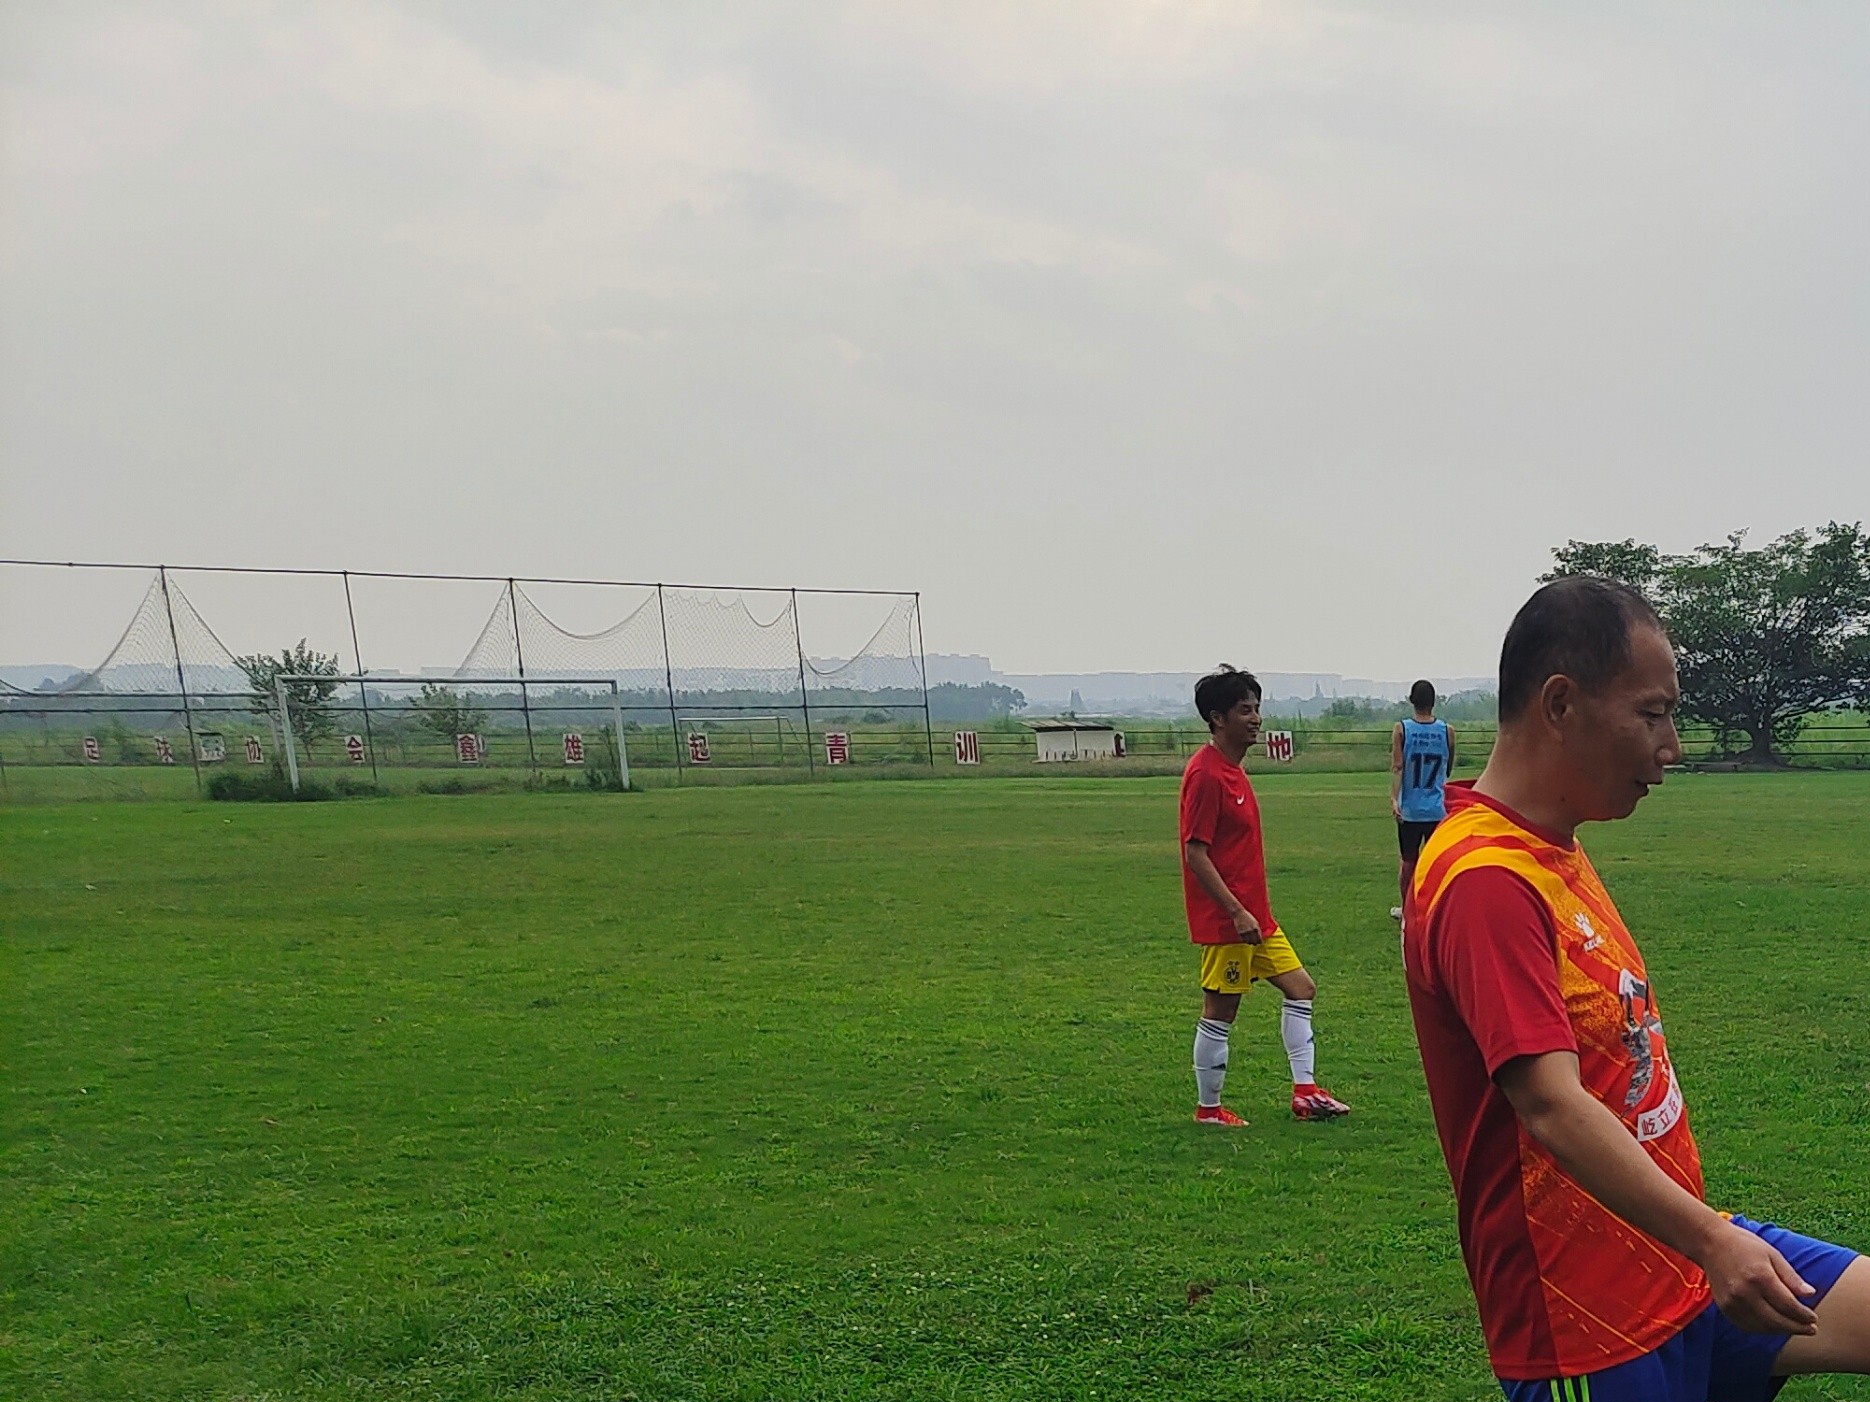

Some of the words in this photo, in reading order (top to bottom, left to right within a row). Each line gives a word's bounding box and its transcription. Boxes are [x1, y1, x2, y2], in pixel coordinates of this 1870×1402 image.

[346, 735, 363, 763] 会
[564, 734, 584, 762] 雄
[688, 733, 711, 762] 起
[826, 734, 847, 763] 青
[956, 732, 979, 763] 训
[1267, 732, 1291, 760] 地
[1410, 752, 1442, 789] 17
